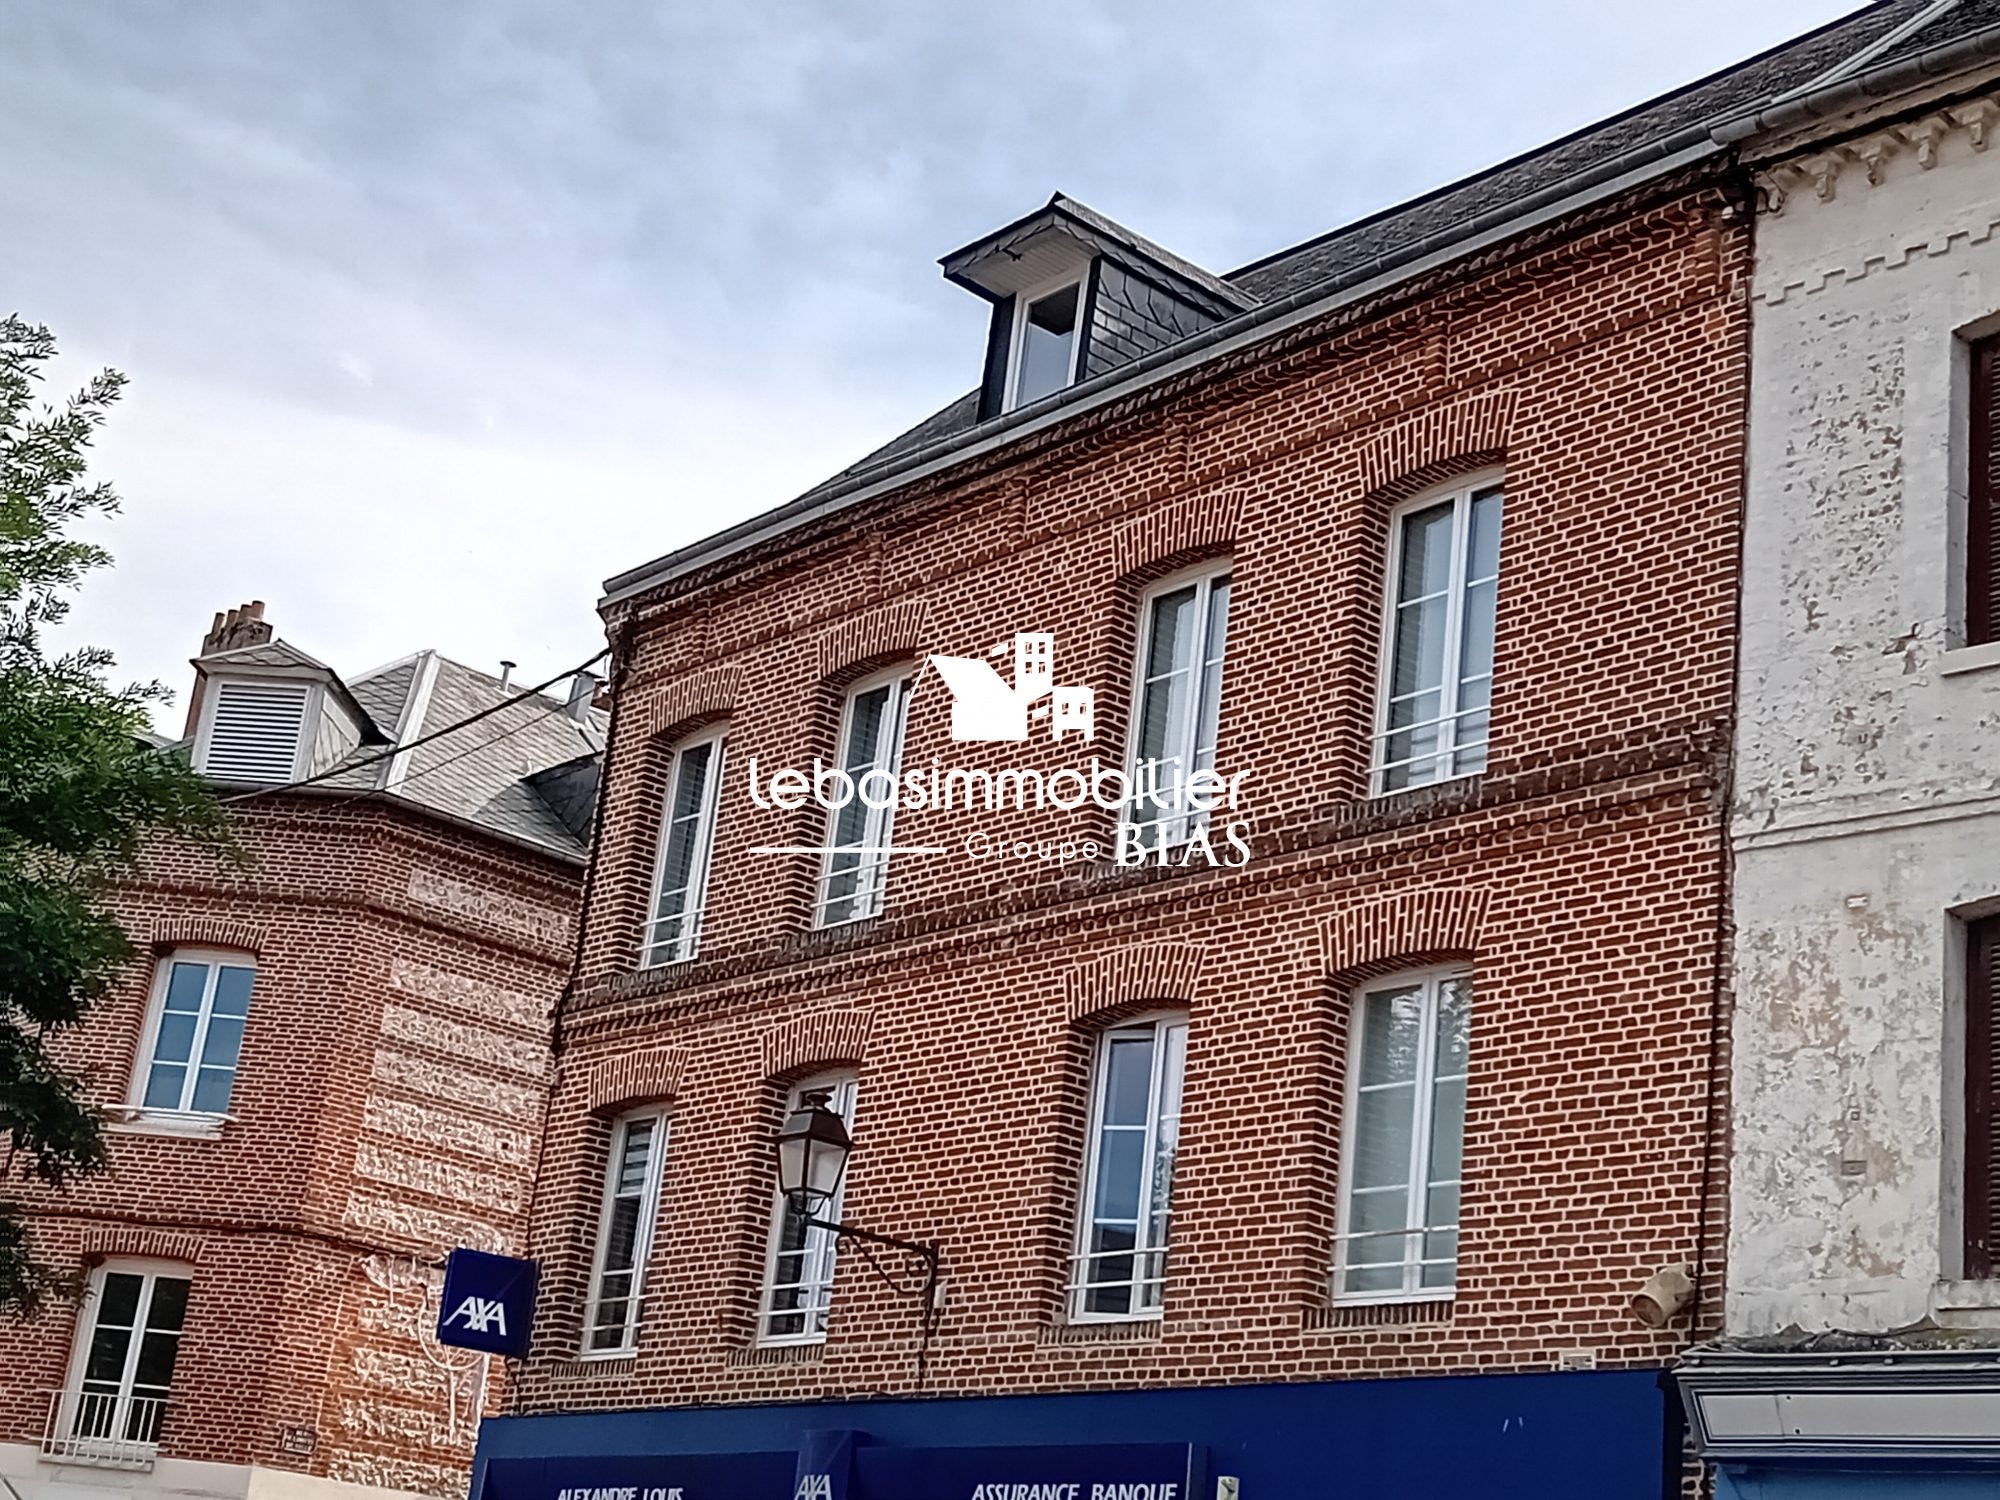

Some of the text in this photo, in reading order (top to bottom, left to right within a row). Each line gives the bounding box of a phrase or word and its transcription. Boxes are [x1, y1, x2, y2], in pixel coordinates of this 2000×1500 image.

[442, 1295, 507, 1336] AXA
[557, 1487, 683, 1500] ALEXANDRE LOUIS
[794, 1474, 833, 1500] AXA
[971, 1483, 1178, 1500] ASSURANCE BANQUE
